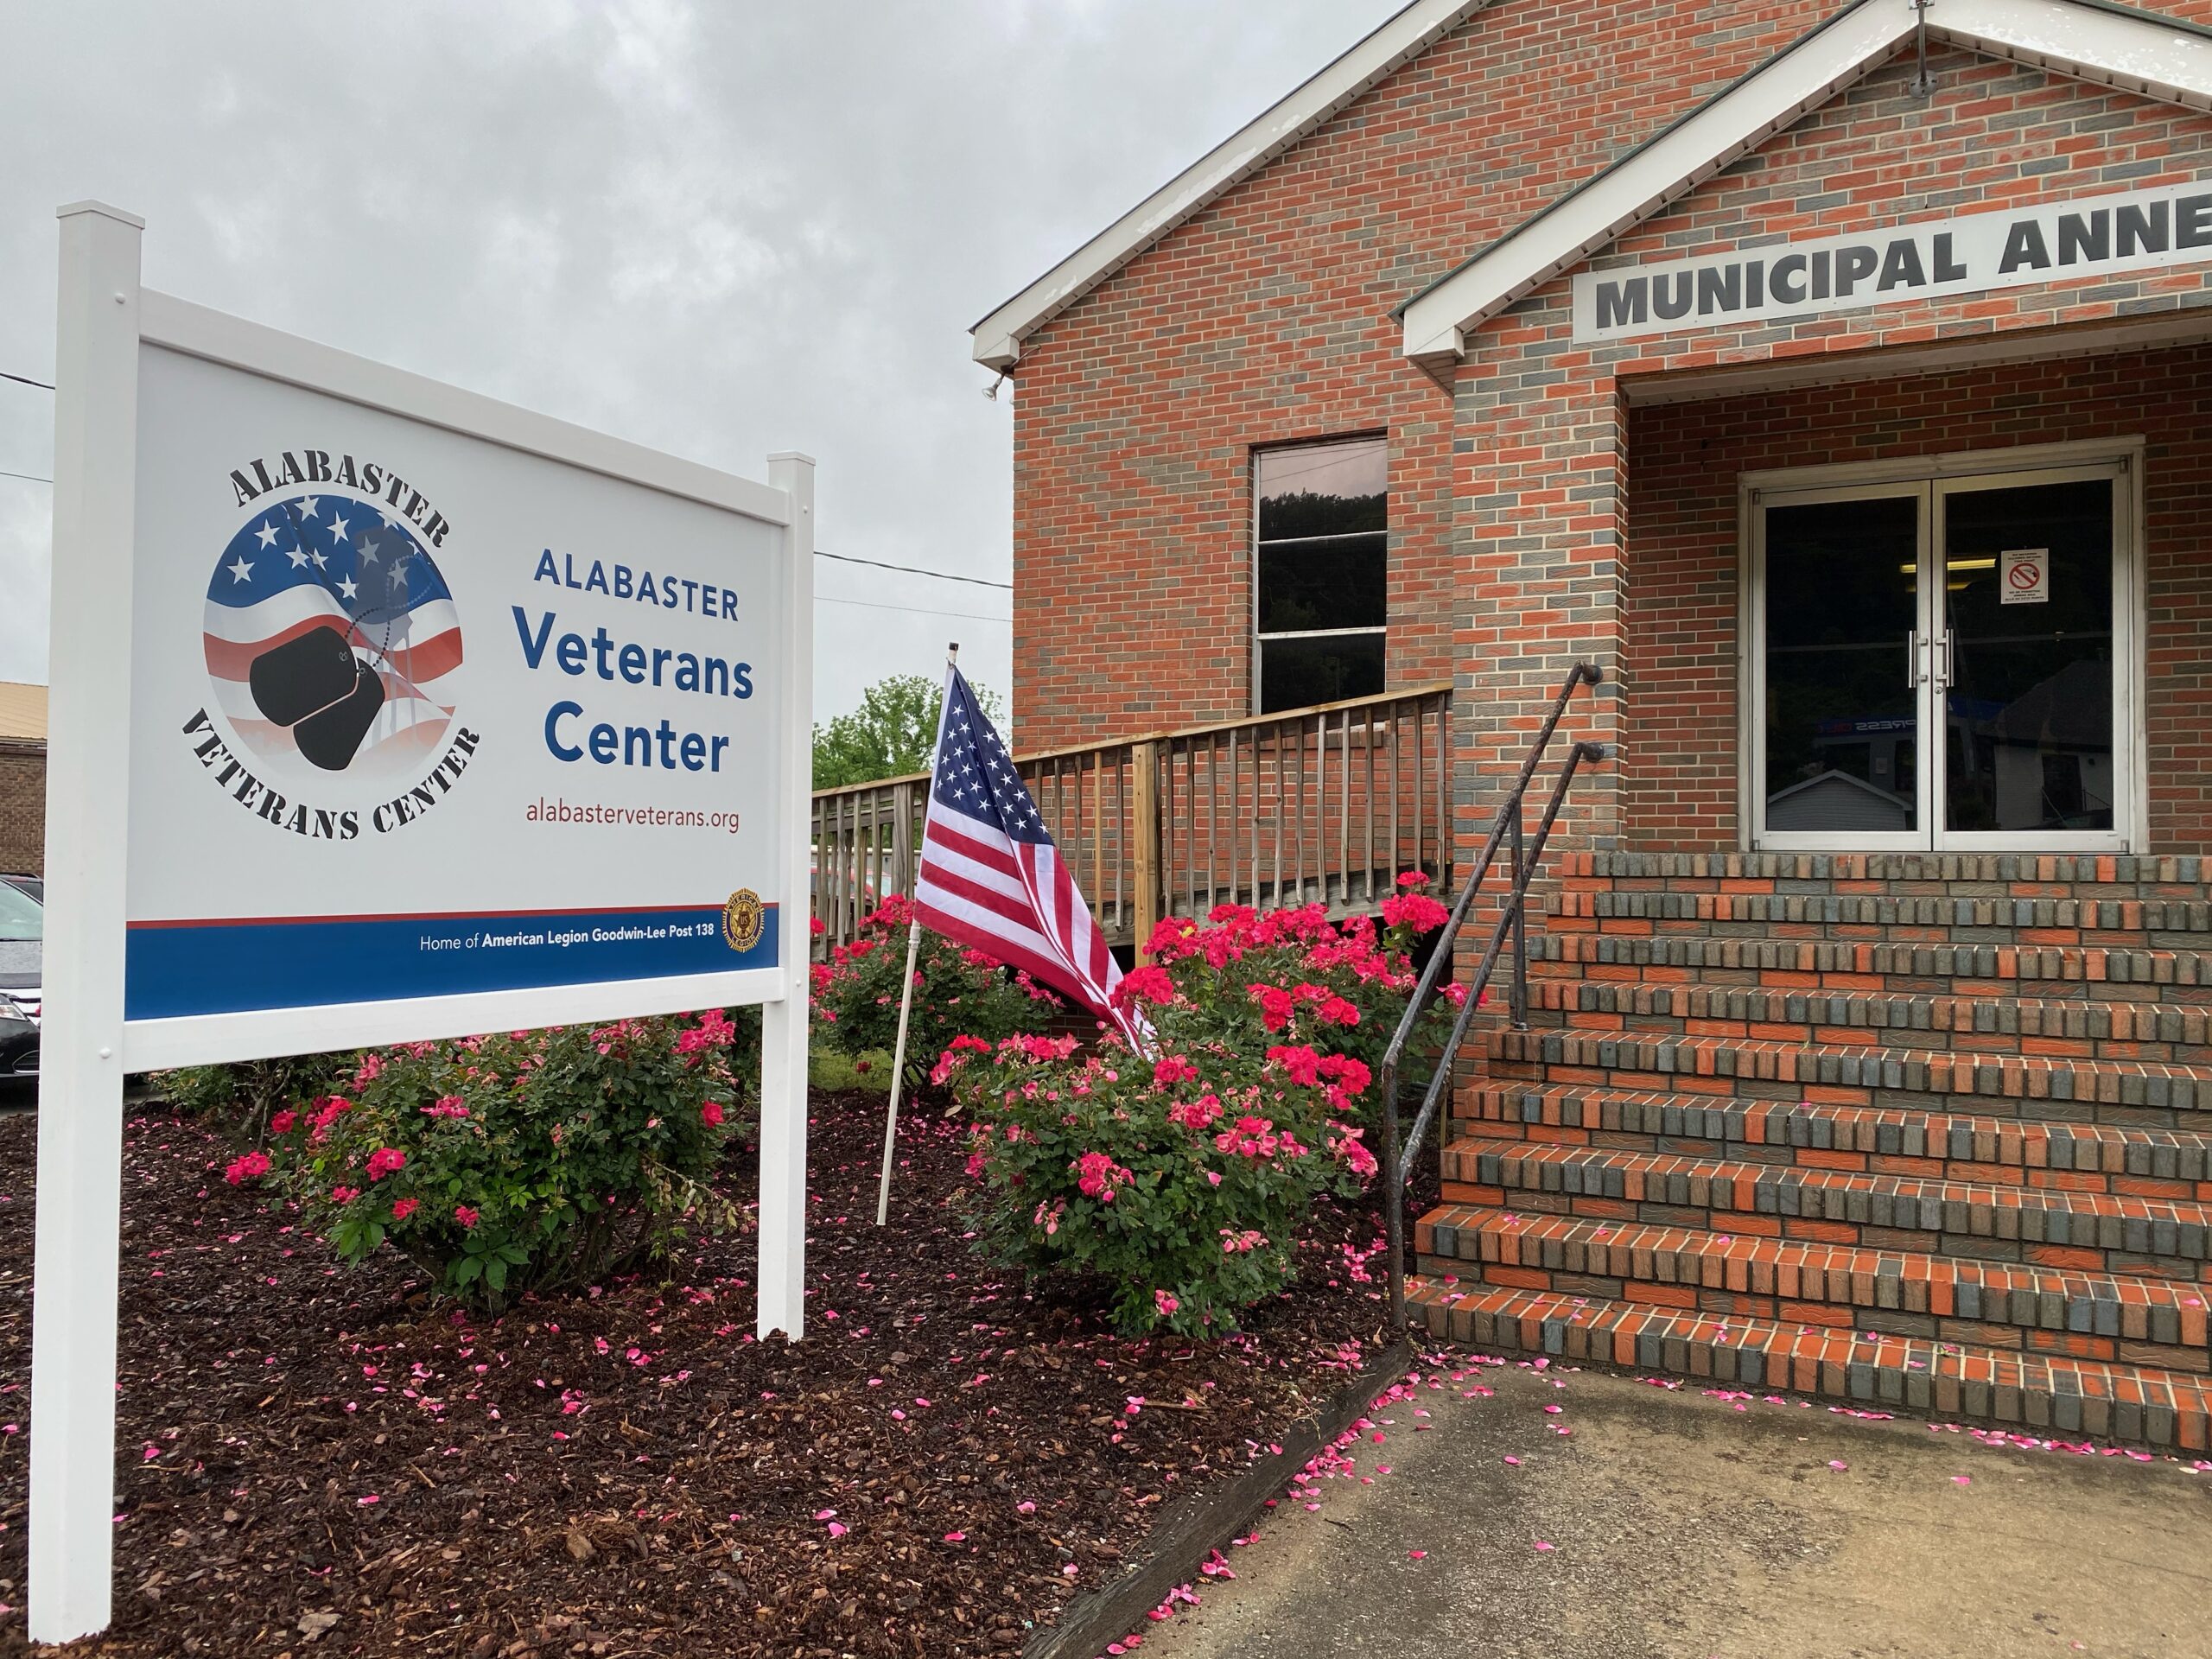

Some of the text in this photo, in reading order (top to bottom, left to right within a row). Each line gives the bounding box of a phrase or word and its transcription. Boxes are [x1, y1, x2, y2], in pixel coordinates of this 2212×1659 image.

[1596, 232, 1967, 329] MUNICIPAL
[230, 449, 449, 548] ALABASTER
[534, 548, 739, 621] ALABASTER
[512, 605, 753, 699] Veterans
[182, 708, 480, 840] VETERANS CENTER
[544, 701, 729, 772] Center
[526, 797, 740, 834] alabasterveterans.org
[420, 923, 715, 950] Home of American Legion Goodwin-Lee Post 138
